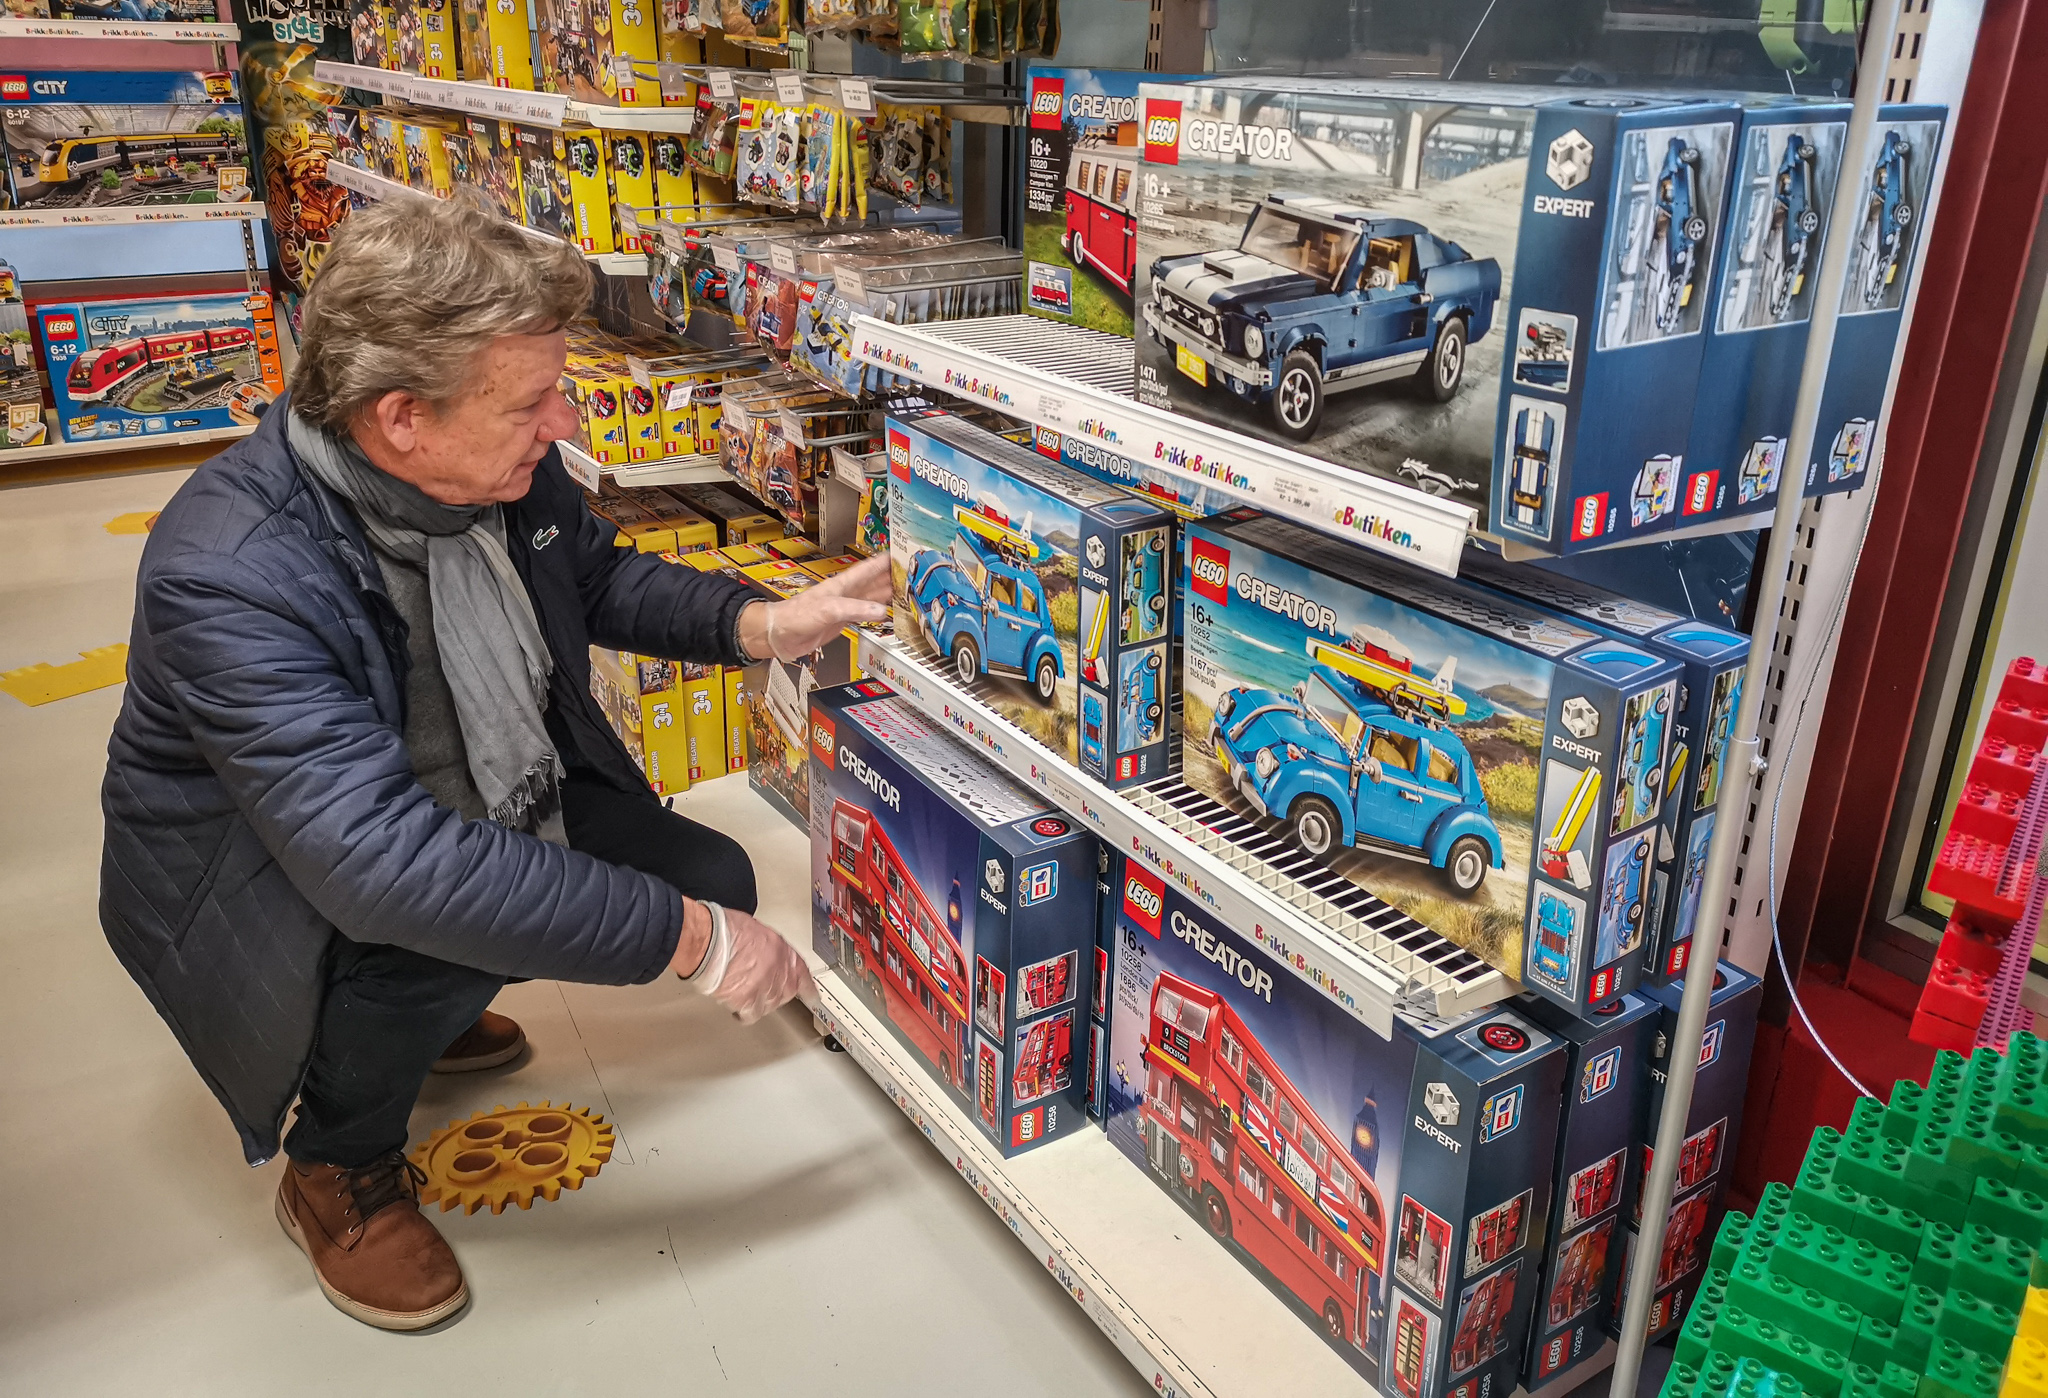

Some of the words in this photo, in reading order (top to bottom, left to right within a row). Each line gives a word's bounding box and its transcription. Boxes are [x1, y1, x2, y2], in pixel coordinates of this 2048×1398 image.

[2, 82, 27, 92] LEGO
[33, 80, 68, 95] CITY
[6, 109, 31, 119] 6-12
[741, 111, 753, 119] LEGO
[1034, 92, 1061, 115] LEGO
[1030, 137, 1052, 156] 16+
[1148, 116, 1179, 144] LEGO
[1187, 119, 1294, 161] CREATOR
[1029, 159, 1048, 170] 10220
[221, 172, 244, 187] UP
[1143, 172, 1171, 198] 16+
[1029, 189, 1046, 201] 1334
[1533, 195, 1594, 219] EXPERT
[581, 203, 590, 236] CREATOR
[1142, 201, 1164, 216] 10265
[801, 284, 816, 294] LEGO
[817, 290, 850, 312] CREATOR
[47, 321, 75, 334] LEGO
[90, 315, 130, 332] CITY
[50, 344, 77, 355] 6-12
[1139, 365, 1157, 381] 1471
[944, 369, 1015, 407] BrikkeButikken.no
[598, 450, 608, 462] LEGO
[634, 446, 645, 459] LEGO
[665, 441, 676, 453] LEGO
[1037, 429, 1061, 451] LEGO
[1066, 438, 1133, 482] CREATOR
[890, 443, 911, 470] LEGO
[912, 454, 970, 503] CREATOR
[1154, 441, 1256, 493] BrikkeButikken.no
[1807, 462, 1818, 487] 10265
[891, 482, 905, 502] 16+
[1692, 472, 1710, 513] LEGO
[1716, 484, 1726, 510] 10265
[1580, 496, 1600, 538] LEGO
[1606, 506, 1617, 534] 10265
[1082, 565, 1110, 589] EXPERT
[1194, 554, 1228, 587] LEGO
[1235, 572, 1338, 637] CREATOR
[1190, 602, 1214, 628] 16+
[1190, 623, 1211, 641] 10252
[1190, 655, 1208, 673] 1167
[943, 704, 1008, 759] BrikkeButikken.no
[1551, 734, 1602, 764] EXPERT
[813, 726, 834, 754] LEGO
[839, 744, 901, 813] CREATOR
[1120, 755, 1133, 781] LEGO
[1140, 753, 1149, 776] 10252
[1131, 835, 1222, 912] BrikkeButikken.no
[980, 887, 1009, 916] EXPERT
[1121, 925, 1147, 958] 16+
[1125, 877, 1162, 918] LEGO
[1169, 909, 1274, 1005] CREATOR
[1120, 947, 1143, 972] 10258
[1255, 923, 1364, 1016] BrikkeButikken.no
[1672, 943, 1686, 971] LEGO
[1119, 961, 1139, 982] London
[1138, 978, 1149, 990] Bus
[1119, 972, 1137, 993] 1686
[1595, 970, 1608, 998] LEGO
[1613, 965, 1624, 993] 10252
[1164, 1027, 1170, 1038] 9
[1163, 1042, 1188, 1064] BRICKSTON
[1021, 1111, 1037, 1142] LEGO
[1048, 1104, 1057, 1134] 10258
[1414, 1115, 1462, 1155] EXPERT
[1649, 1300, 1663, 1332] LEGO
[1671, 1288, 1684, 1320] 10258
[1548, 1337, 1563, 1371] LEGO
[1573, 1325, 1584, 1358] 10258
[1482, 1372, 1493, 1398] 0258
